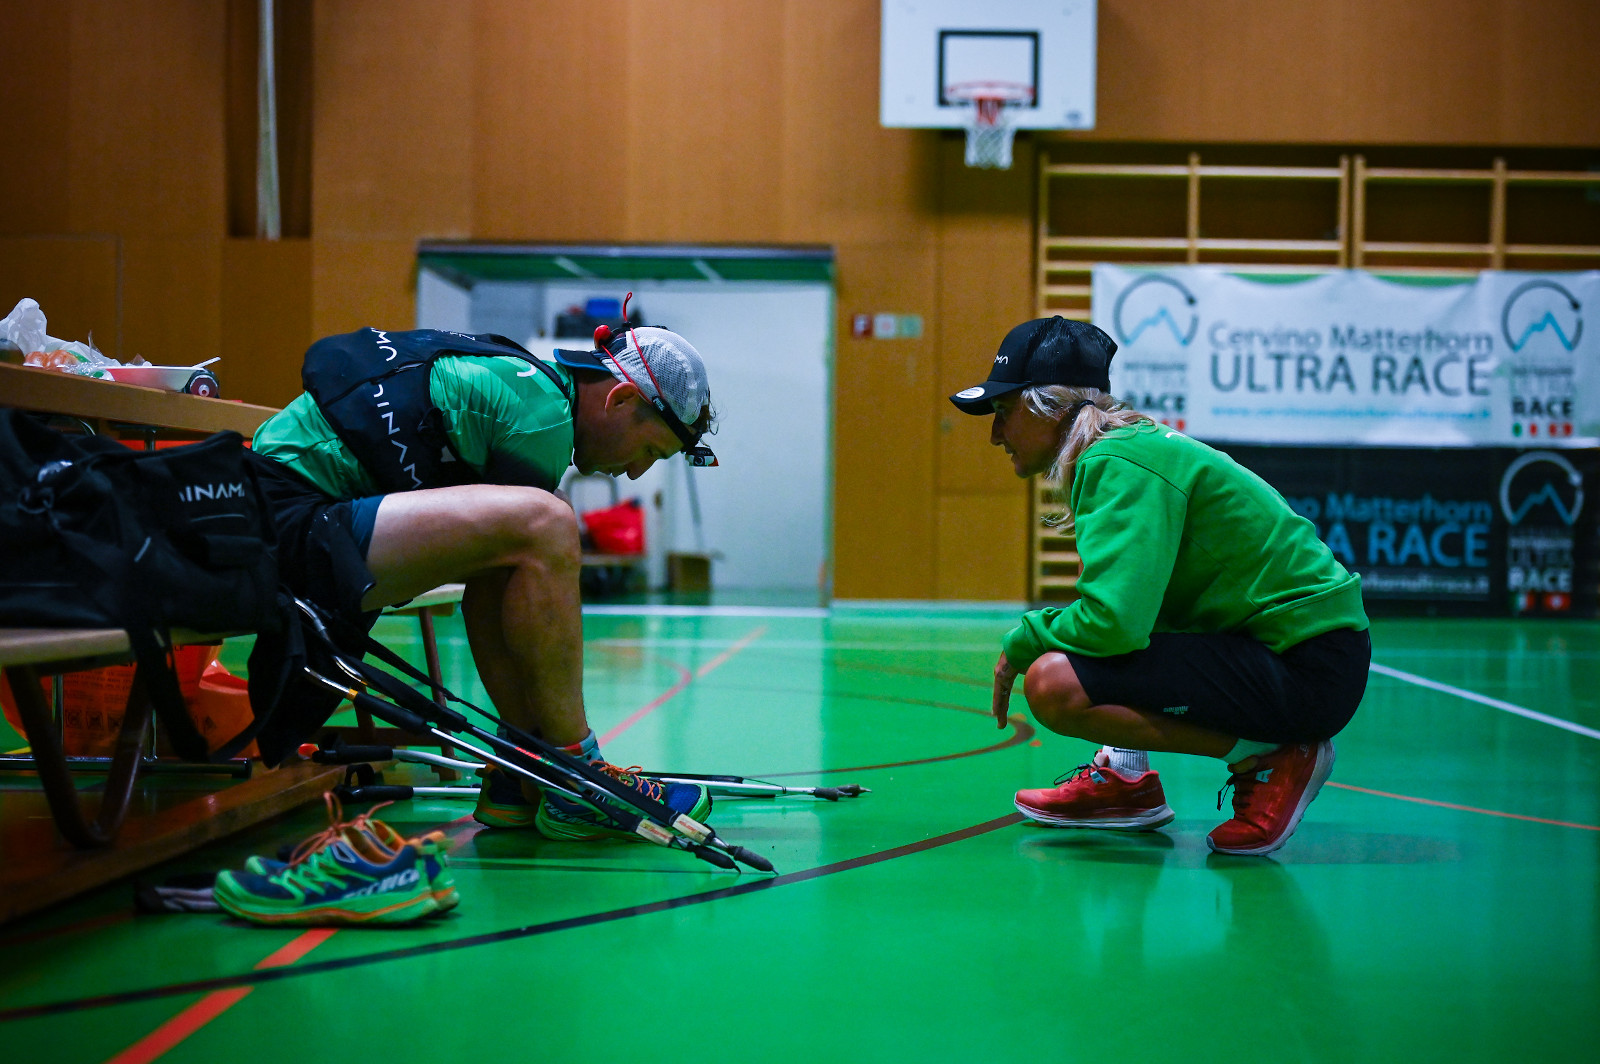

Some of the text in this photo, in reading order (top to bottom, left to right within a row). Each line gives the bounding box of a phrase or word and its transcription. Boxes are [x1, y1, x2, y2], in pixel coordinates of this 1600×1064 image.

[1208, 320, 1494, 352] Cervino Matterhorn
[1210, 351, 1491, 397] ULTRA RACE
[1511, 396, 1574, 418] RACE
[1325, 490, 1493, 524] Matterhorn
[1367, 521, 1489, 568] RACE
[1507, 567, 1573, 593] RACE
